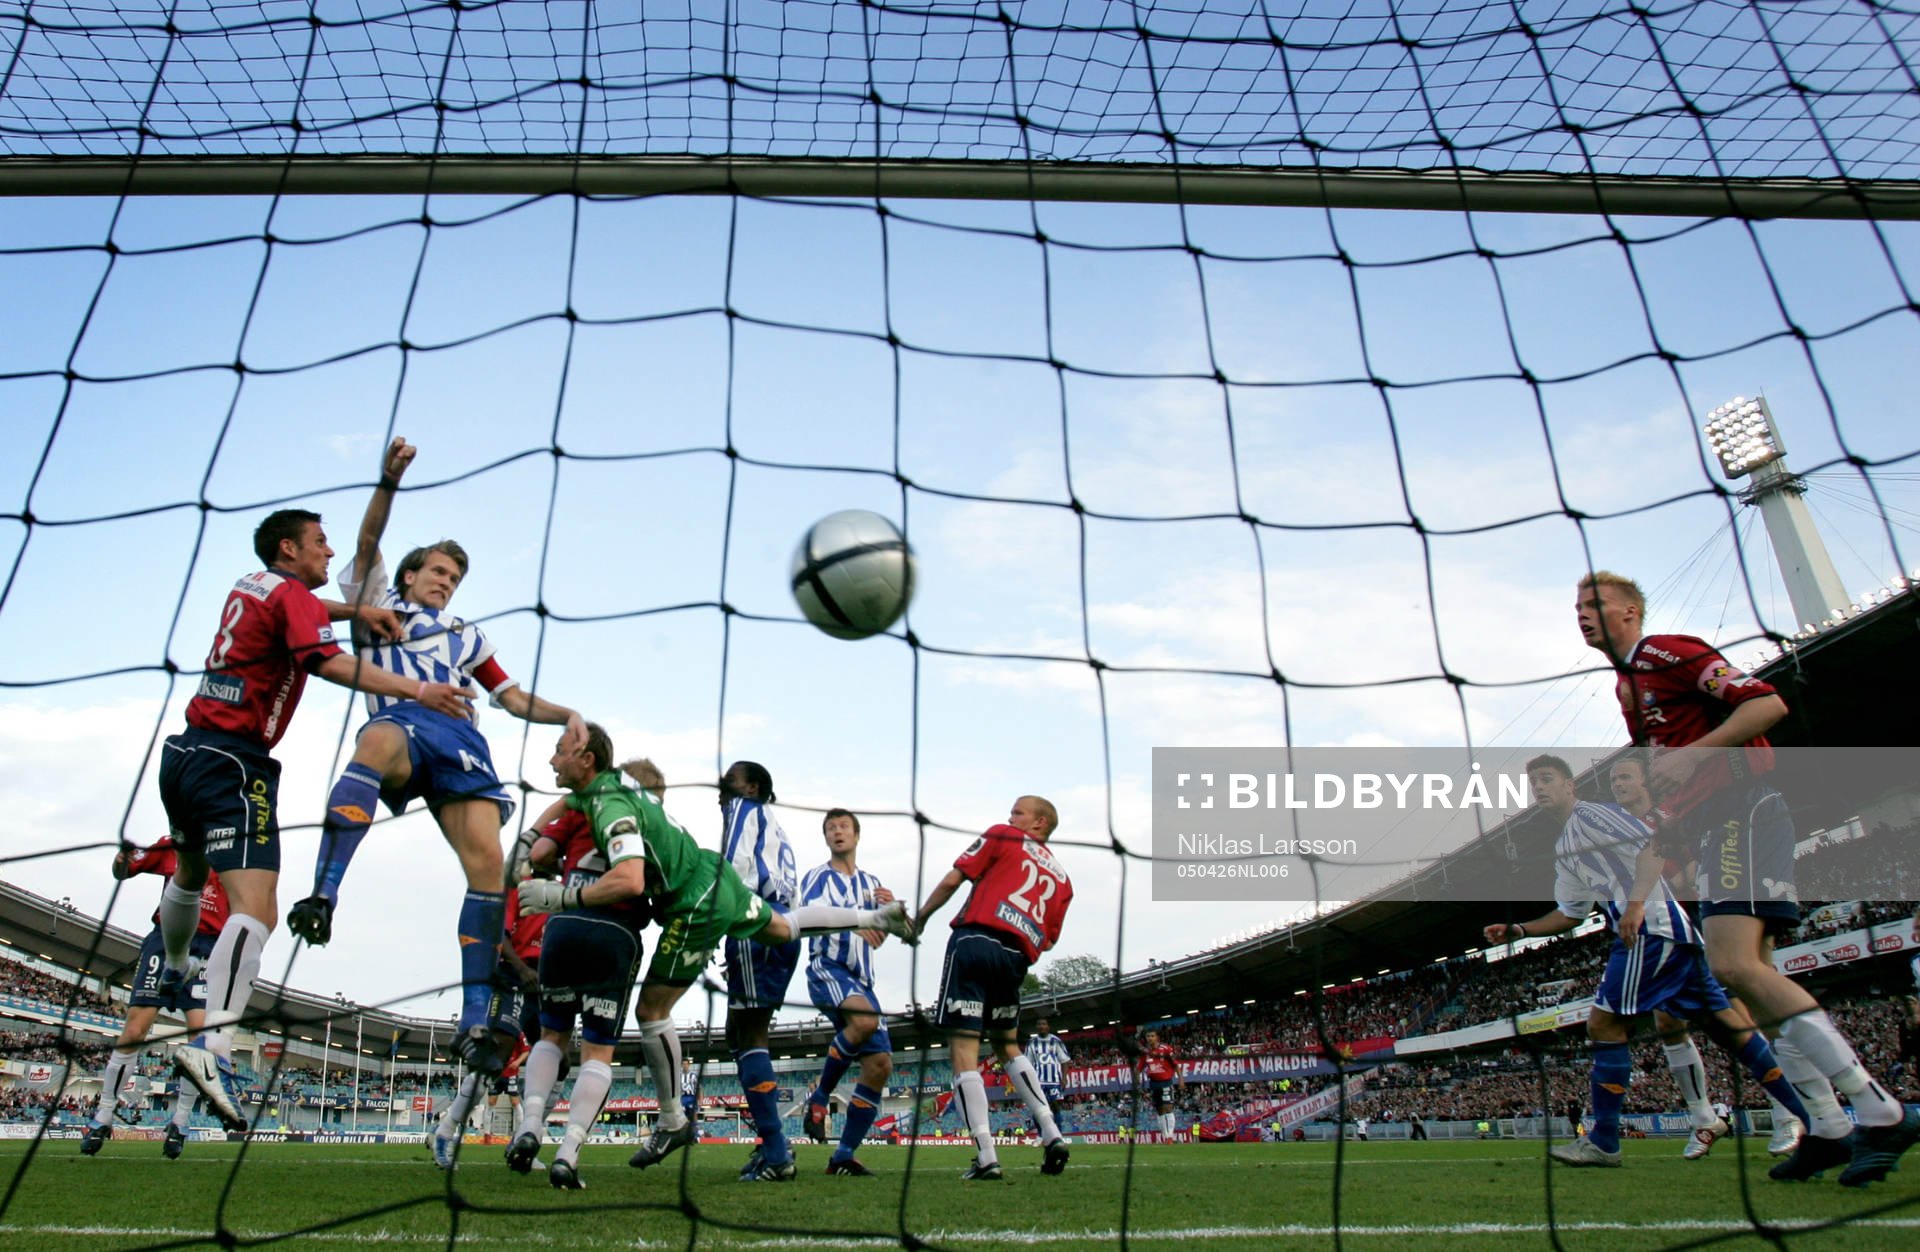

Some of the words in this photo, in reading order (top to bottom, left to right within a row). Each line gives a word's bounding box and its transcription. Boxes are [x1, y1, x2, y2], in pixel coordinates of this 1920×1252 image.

[209, 596, 244, 669] 3
[1720, 819, 1742, 890] OffiTech
[1008, 859, 1056, 924] 23
[997, 903, 1042, 947] Folksam
[149, 955, 160, 975] 9
[1787, 957, 1816, 970] Malaco
[252, 1092, 278, 1102] FALON
[310, 1097, 337, 1105] FALCON
[313, 1136, 341, 1144] VOLVO
